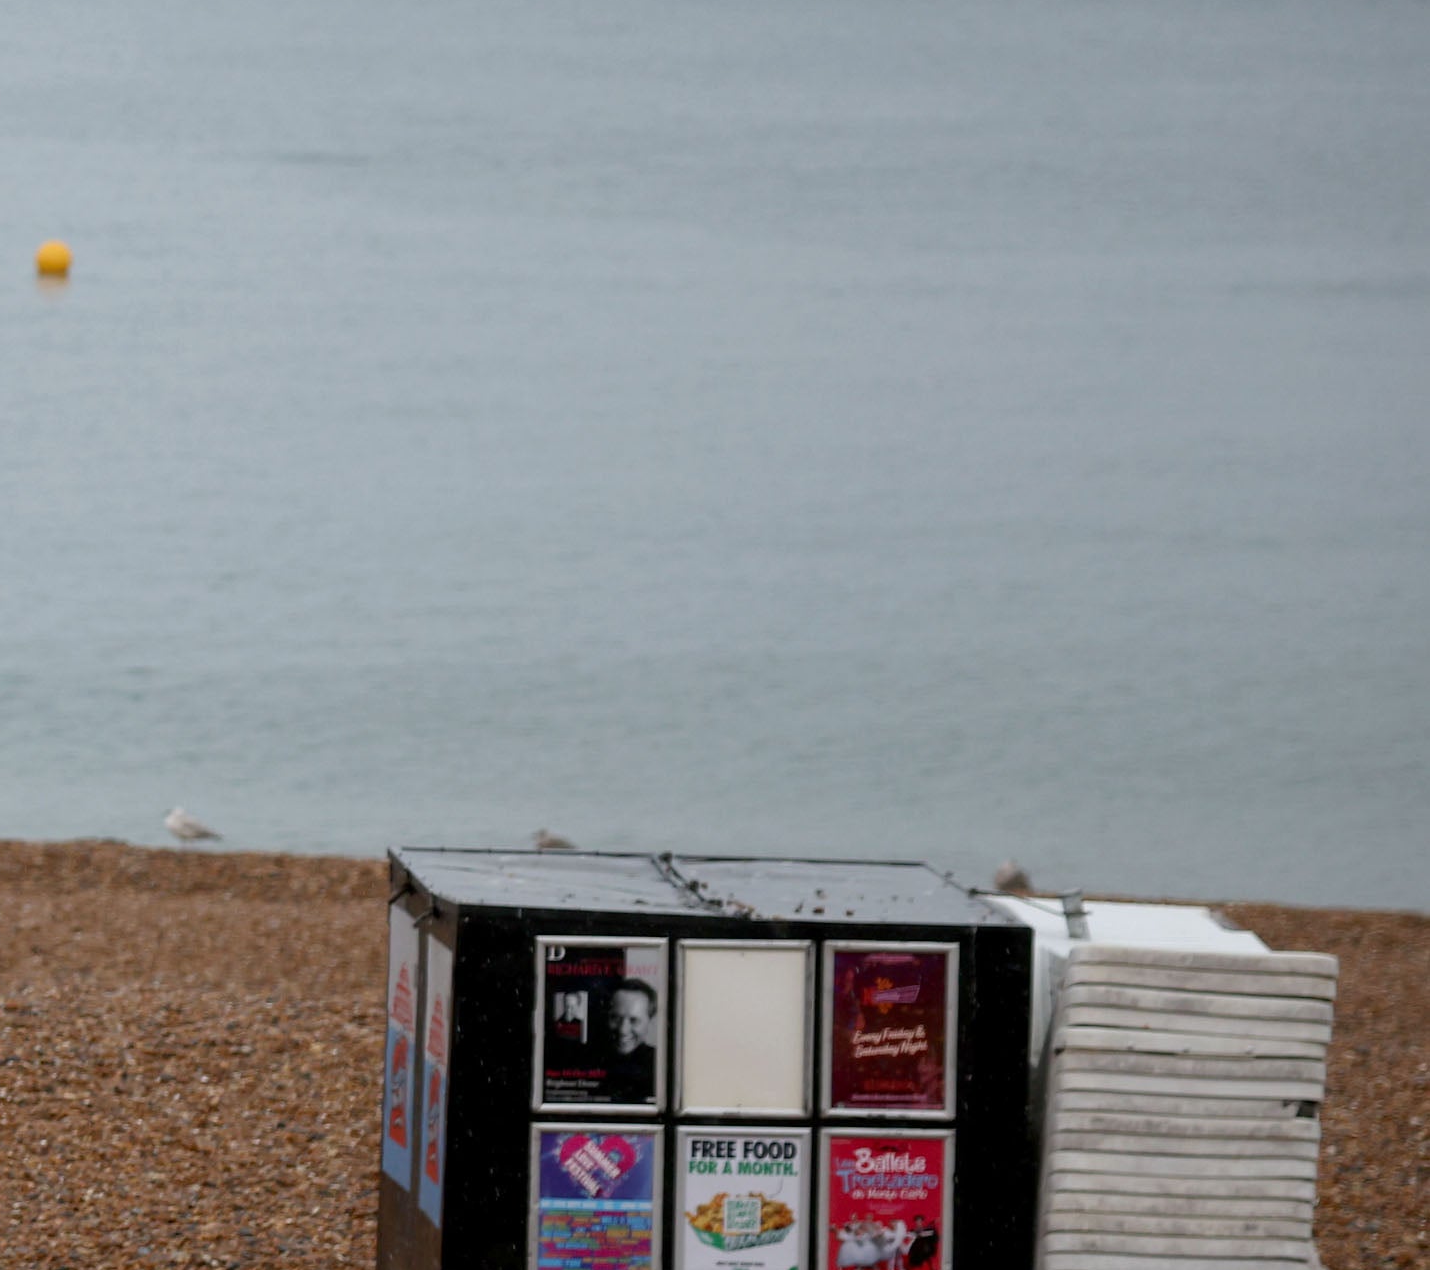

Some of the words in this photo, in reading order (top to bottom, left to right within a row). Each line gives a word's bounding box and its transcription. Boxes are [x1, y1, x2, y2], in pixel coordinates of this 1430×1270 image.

[691, 1140, 737, 1158] FREE
[743, 1141, 797, 1159] FOOD
[688, 1160, 717, 1174] FOR
[722, 1161, 733, 1174] A
[738, 1161, 798, 1176] MONTH.
[854, 1147, 926, 1175] Ballets
